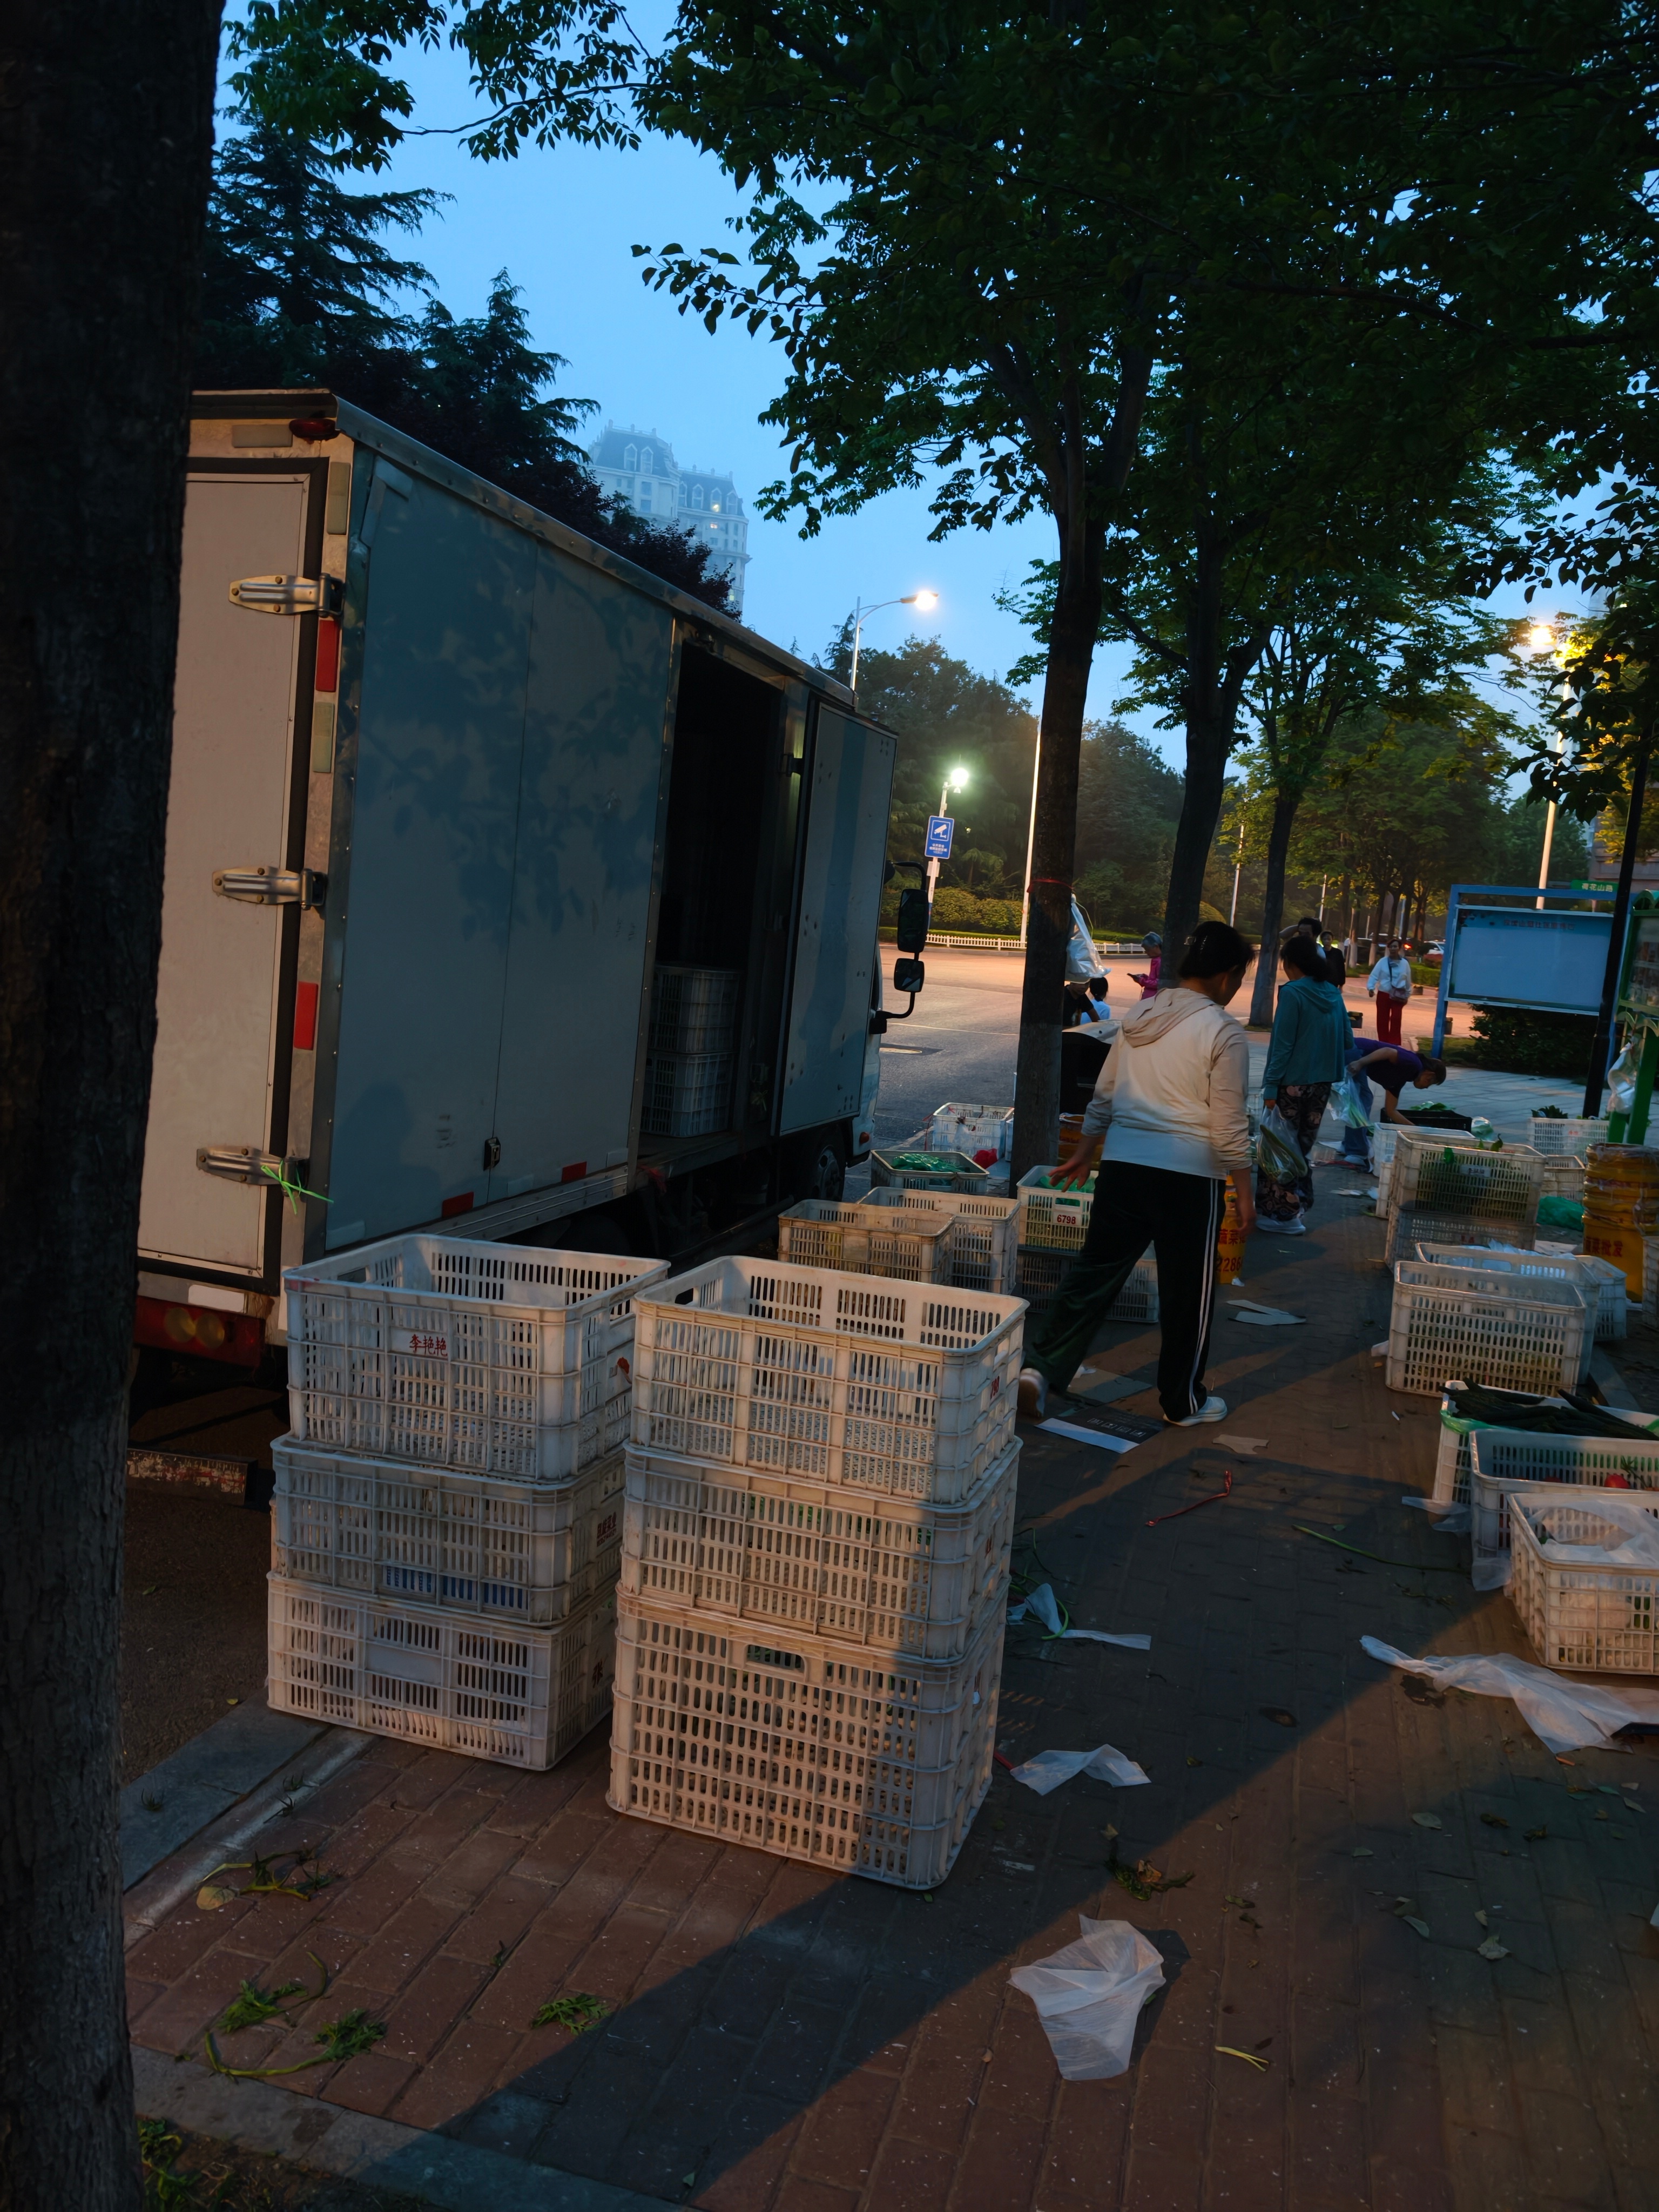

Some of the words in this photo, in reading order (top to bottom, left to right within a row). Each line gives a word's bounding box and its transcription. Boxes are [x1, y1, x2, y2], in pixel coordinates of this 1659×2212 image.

[1057, 1214, 1076, 1224] 6798
[409, 1334, 448, 1357] 李艳艳
